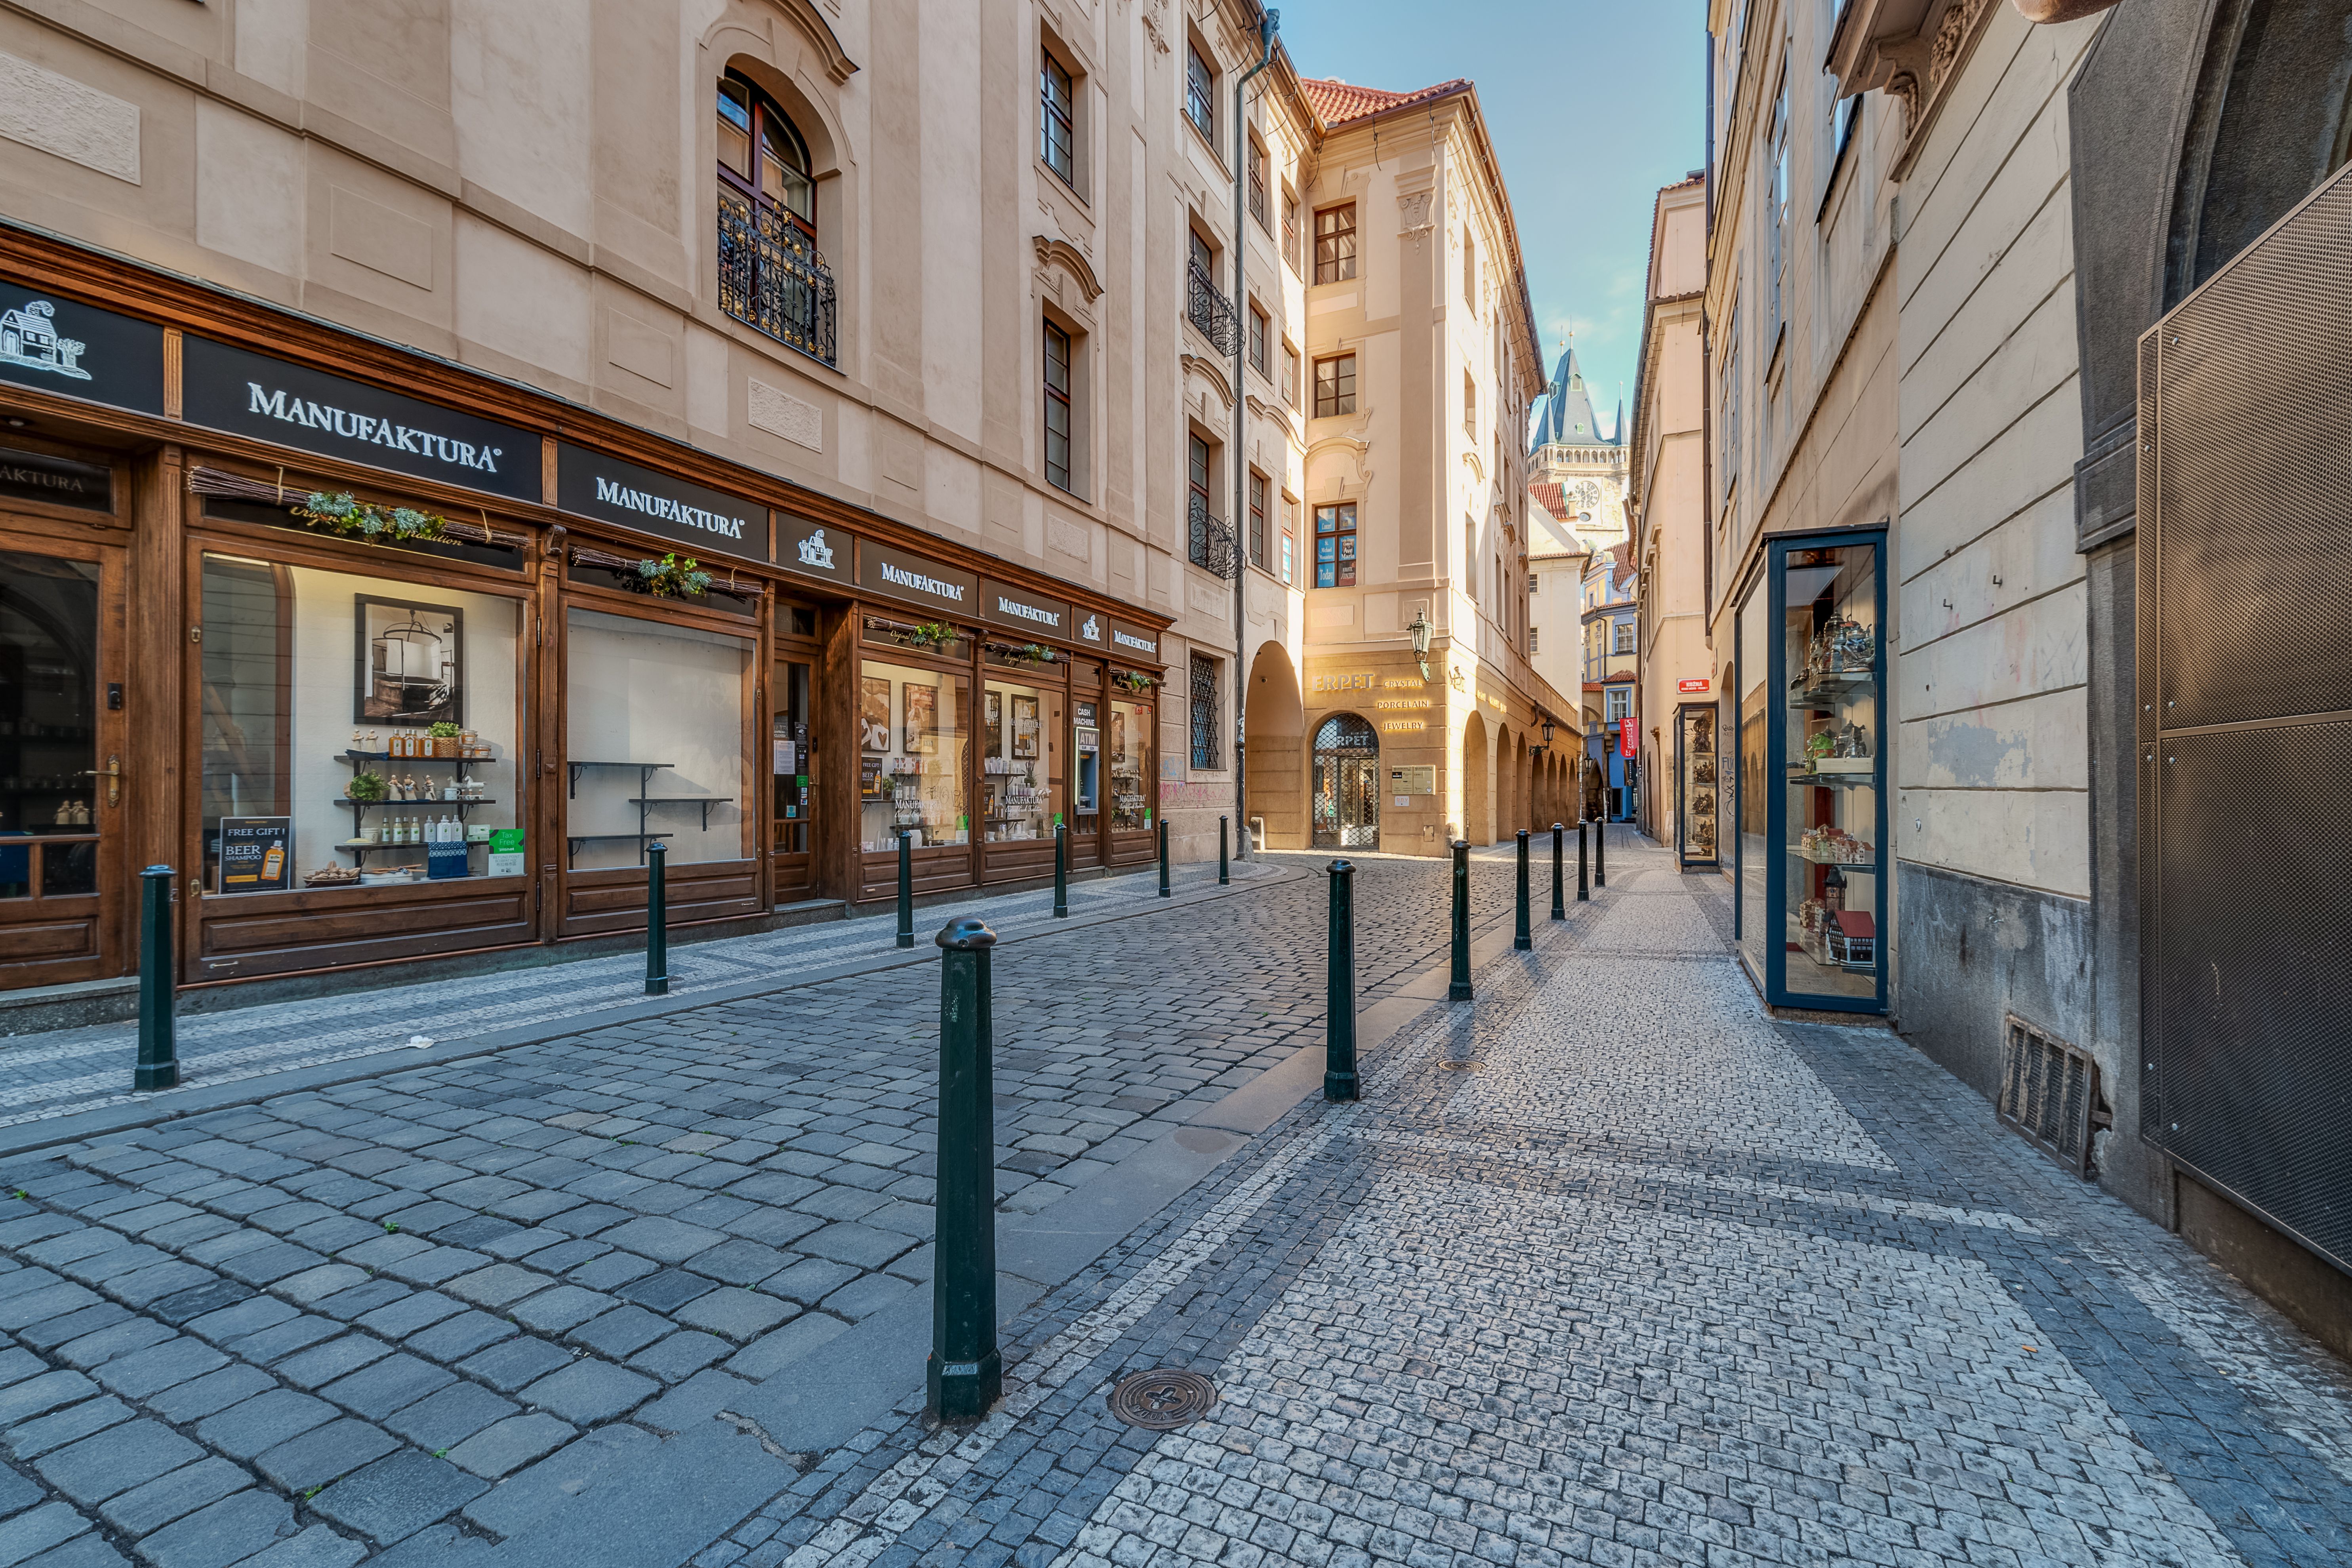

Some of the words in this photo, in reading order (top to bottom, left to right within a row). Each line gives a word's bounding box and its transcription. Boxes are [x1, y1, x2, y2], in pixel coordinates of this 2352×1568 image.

[1320, 569, 1333, 582] Today
[890, 630, 911, 642] Original
[1312, 673, 1374, 691] ERPET
[1377, 700, 1429, 709] PORCELAIN
[1073, 717, 1094, 726] MACHINE
[1384, 722, 1423, 731] JEWELRY
[1080, 732, 1095, 745] ATM
[1337, 735, 1369, 746] RPET
[1006, 796, 1043, 804] MANUFAKTURA
[226, 845, 261, 855] BEER
[1133, 1405, 1165, 1420] VODA
